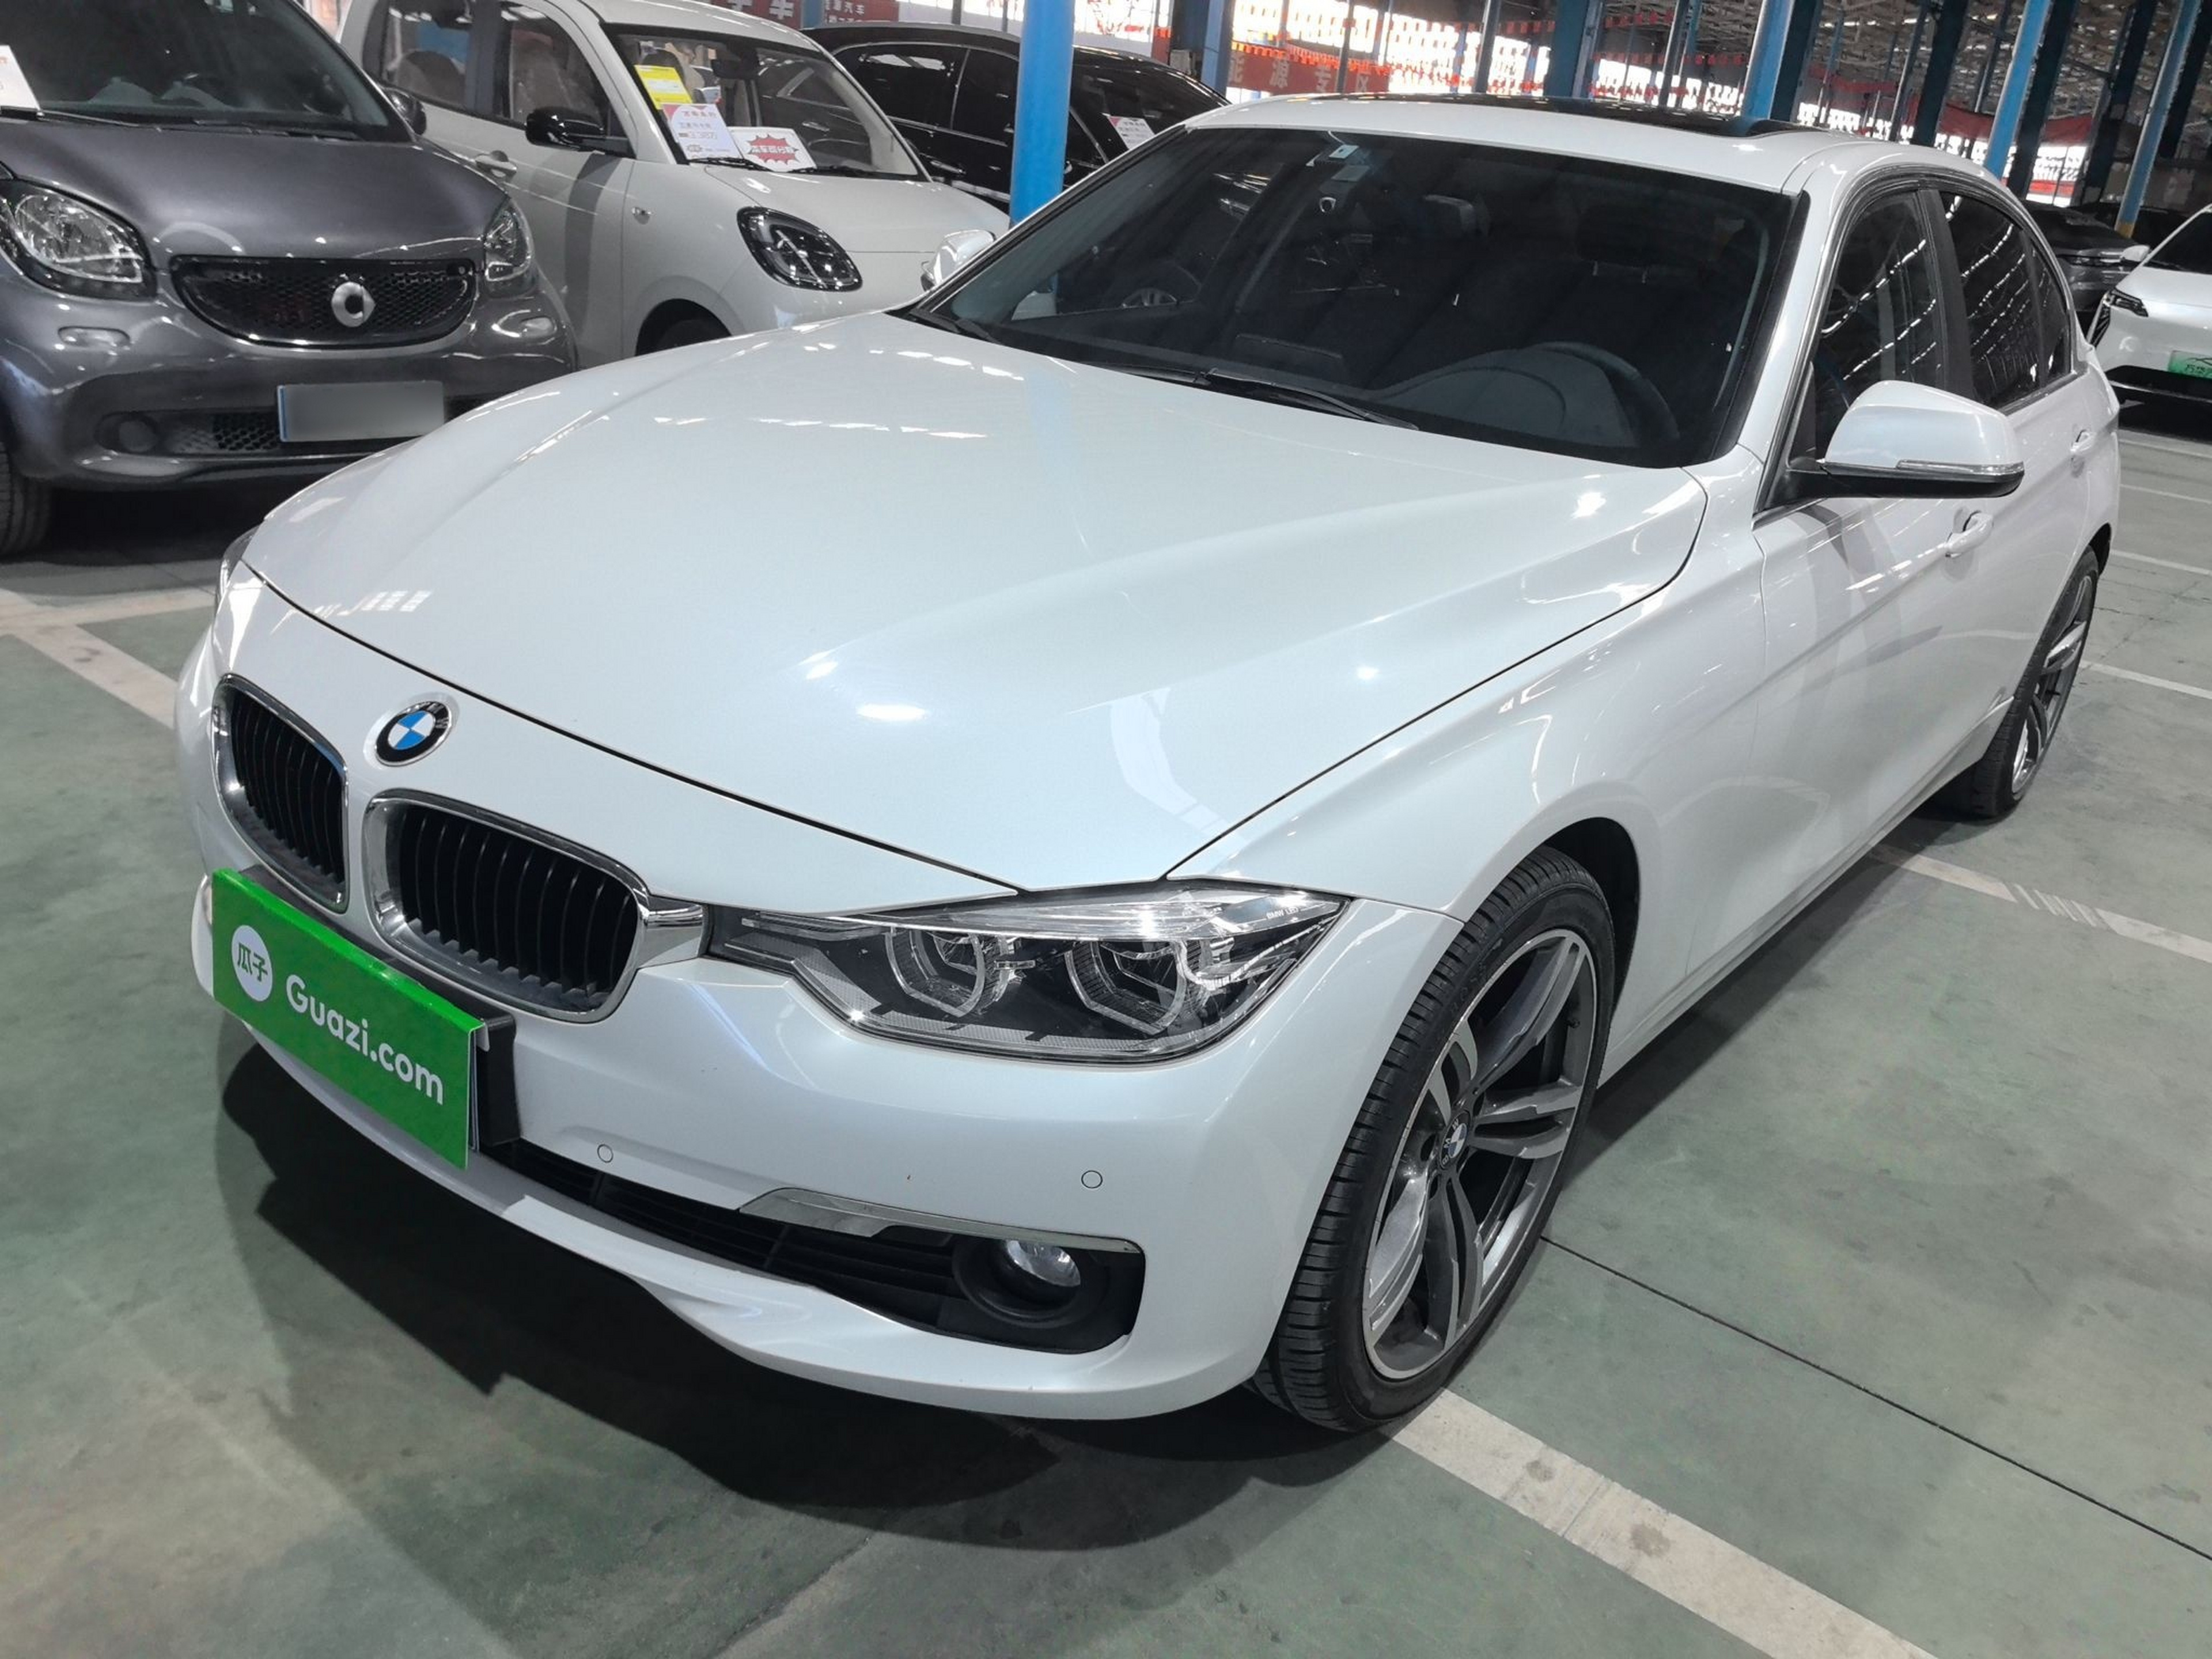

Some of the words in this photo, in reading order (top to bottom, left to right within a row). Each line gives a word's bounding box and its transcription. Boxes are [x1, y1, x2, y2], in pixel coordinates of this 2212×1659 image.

[1267, 909, 1285, 920] BMW
[1285, 907, 1299, 915] LED
[237, 942, 268, 982] 瓜子
[286, 974, 444, 1106] Guazi.com
